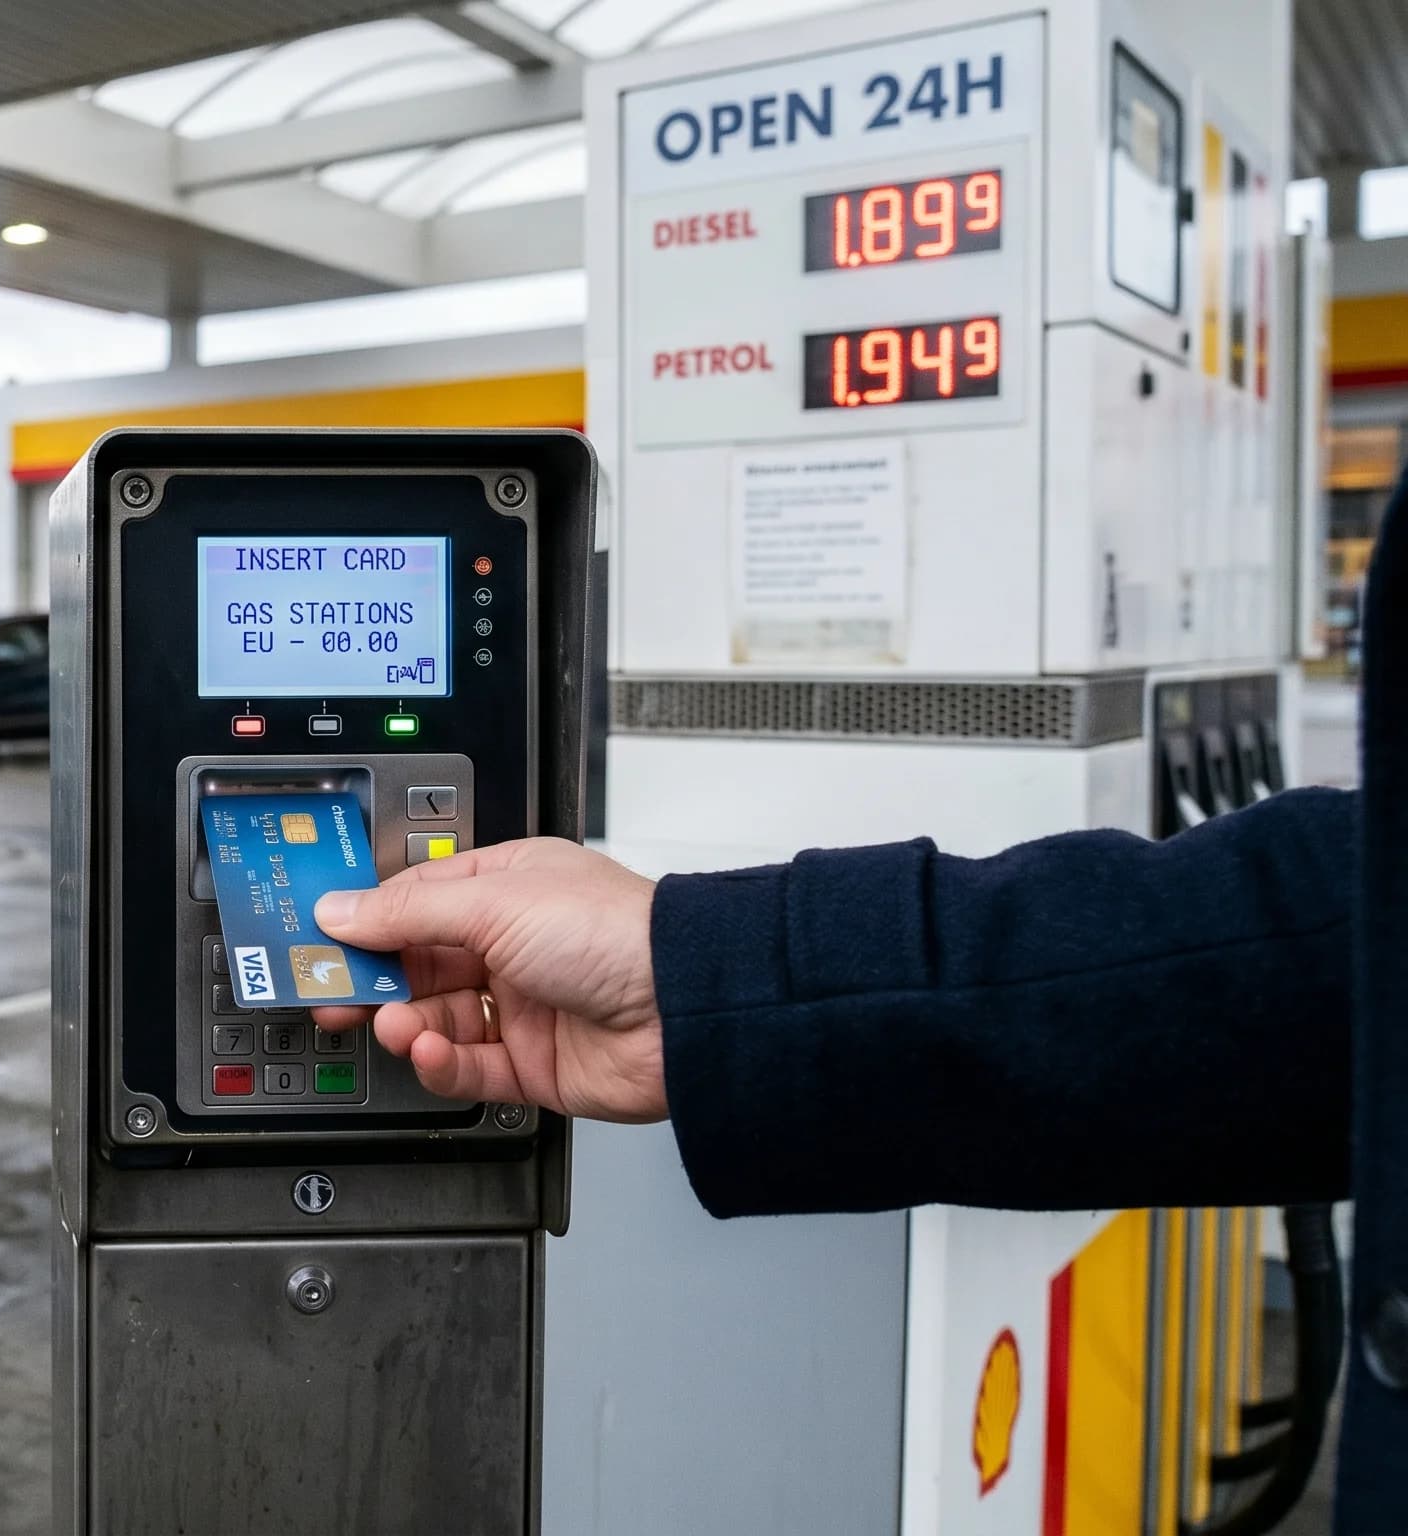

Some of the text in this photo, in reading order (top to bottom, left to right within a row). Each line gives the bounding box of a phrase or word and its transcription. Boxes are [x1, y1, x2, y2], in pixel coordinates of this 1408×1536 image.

[655, 53, 1004, 165] OPEN 24H
[653, 169, 1003, 269] DIESEL 1.899
[653, 317, 1000, 408] PETROL 1.949
[235, 548, 407, 571] INSERT CARD
[227, 602, 414, 625] GAS STATIONS
[243, 631, 274, 653] EU
[322, 631, 398, 653] 00.00
[242, 951, 268, 996] VISA
[230, 1034, 341, 1051] 7 8 9
[279, 1072, 291, 1089] 0
